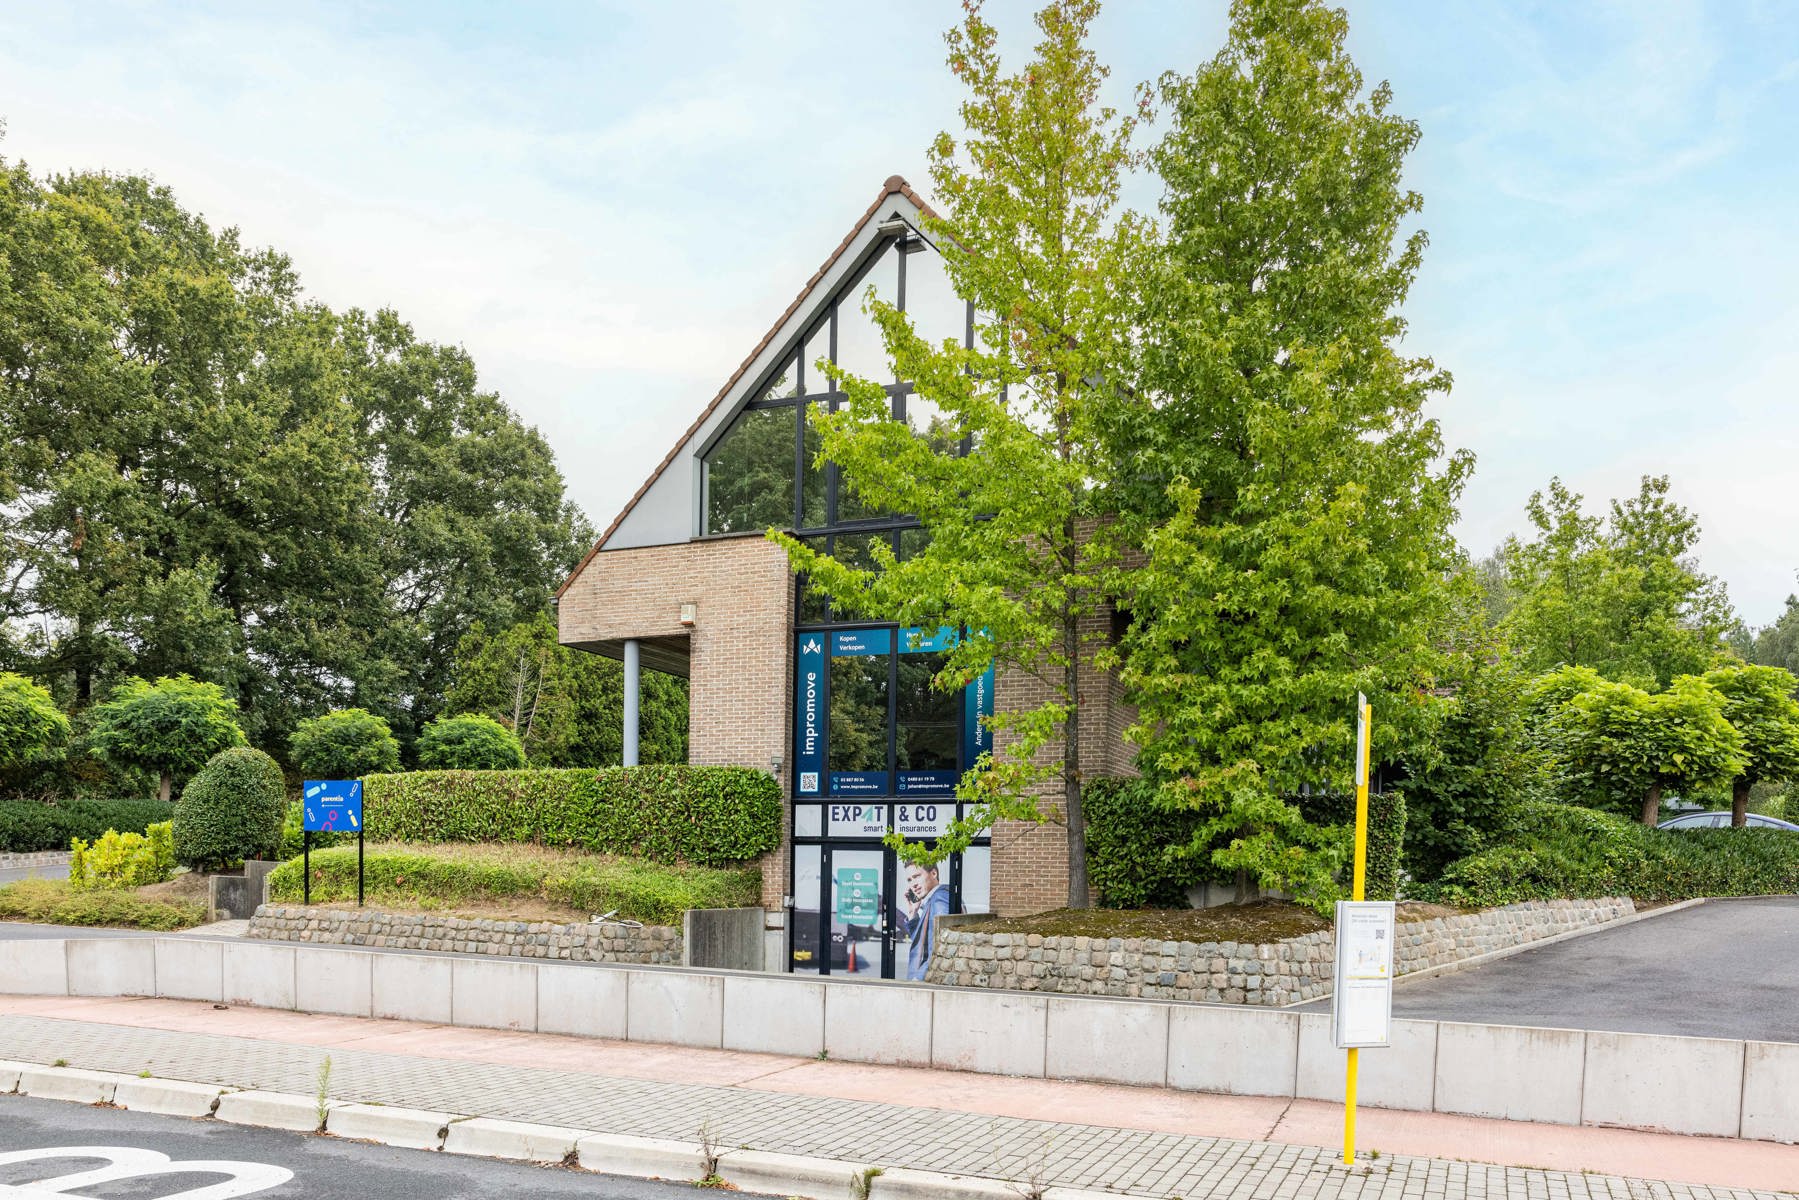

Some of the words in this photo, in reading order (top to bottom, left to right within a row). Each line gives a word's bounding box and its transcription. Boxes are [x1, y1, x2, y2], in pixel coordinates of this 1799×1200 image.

[802, 672, 819, 755] impromove
[898, 806, 910, 822] &
[915, 805, 937, 822] CO
[863, 825, 884, 833] smart
[899, 824, 937, 833] insurances
